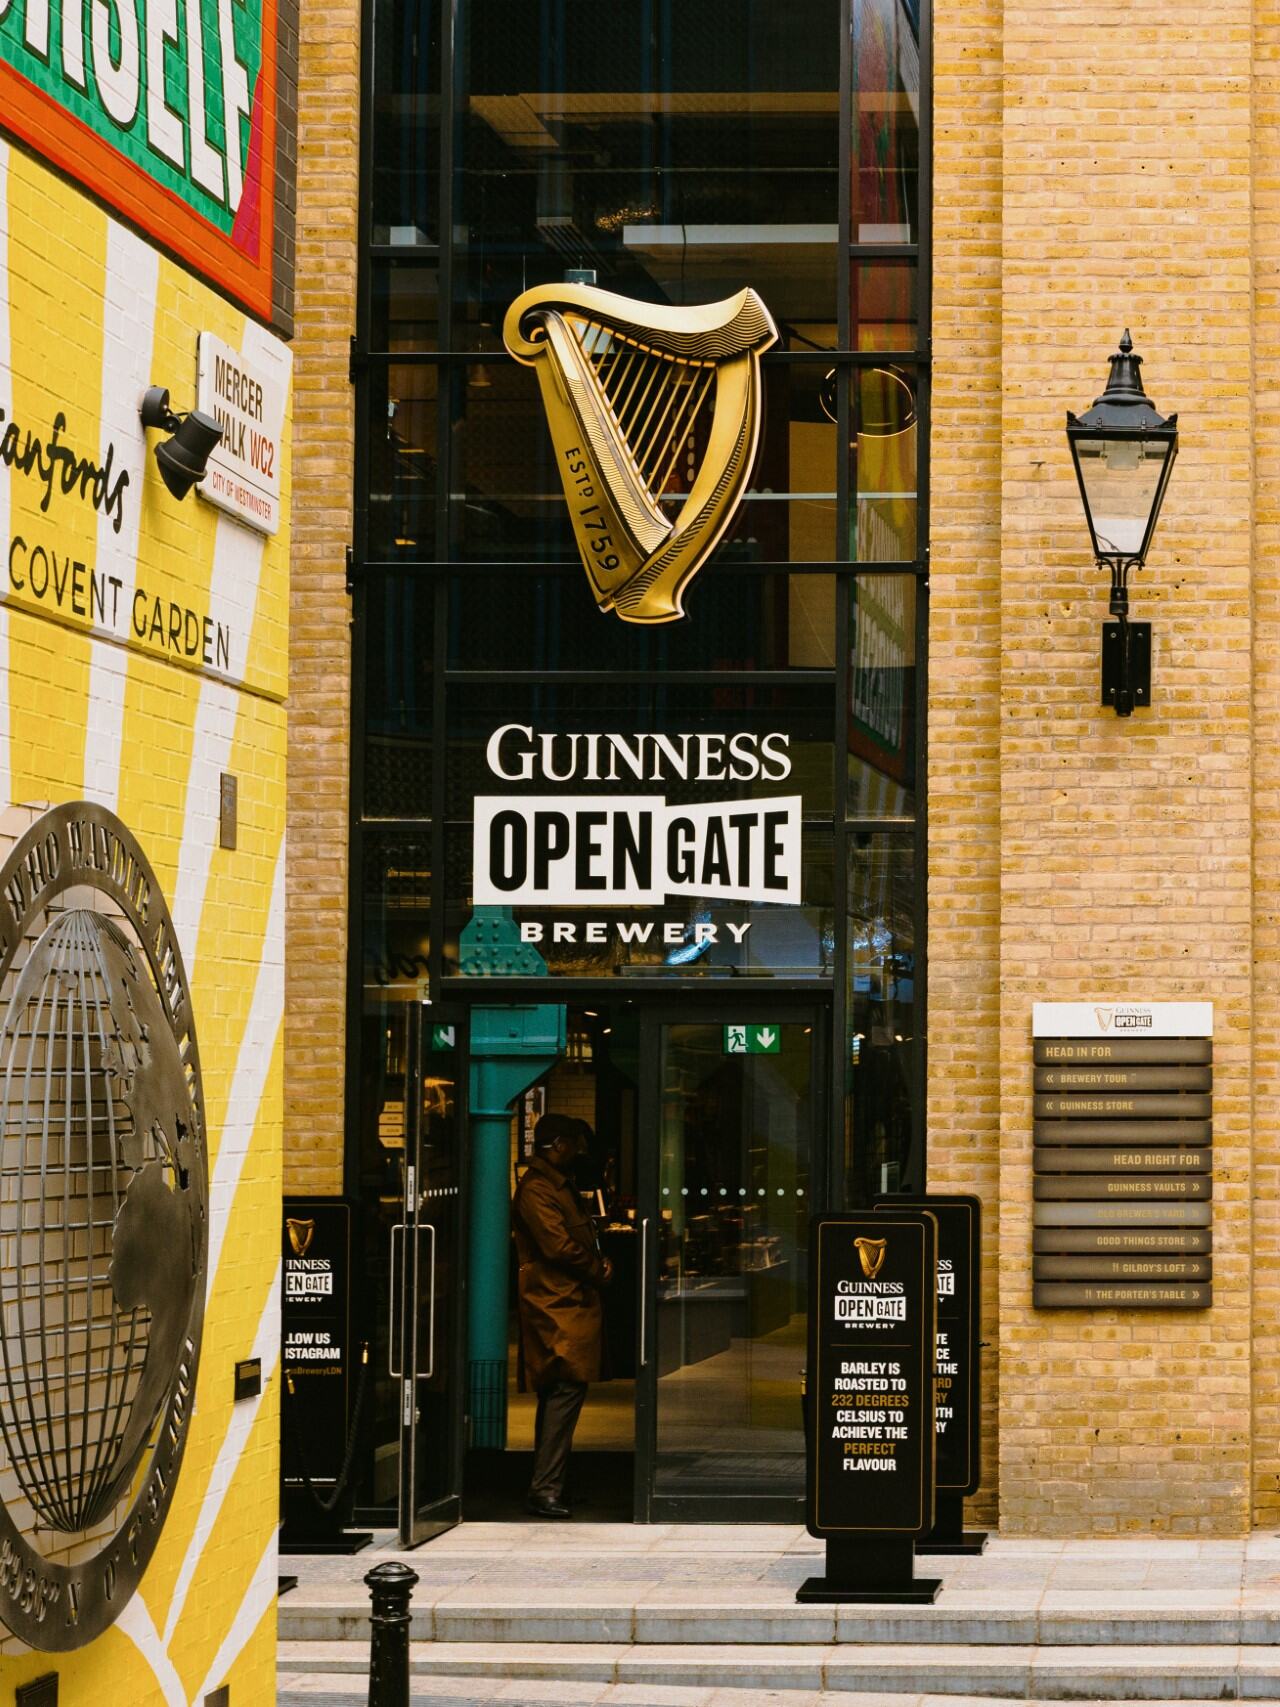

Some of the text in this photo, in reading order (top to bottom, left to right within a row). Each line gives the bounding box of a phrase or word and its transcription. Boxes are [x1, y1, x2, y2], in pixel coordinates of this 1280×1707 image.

[215, 355, 263, 423] MERCER
[249, 428, 275, 479] WC2
[0, 410, 130, 534] anfords
[212, 471, 272, 521] CITY OF WESTMINSTER
[578, 505, 620, 573] 1759
[8, 536, 230, 670] COVENT GARDEN
[486, 724, 792, 781] GUINNESS
[489, 809, 789, 892] OPEN GATE
[520, 922, 752, 943] BREWERY
[1116, 1016, 1152, 1027] OPEN GATE
[1046, 1047, 1112, 1057] HEAD IN FOR
[1060, 1074, 1128, 1083] BREWERY TOUR
[1060, 1101, 1134, 1110] GUINNESS STORE
[1113, 1155, 1200, 1165] HEAD RIGHT FOR
[1107, 1183, 1186, 1192] GUINNESS VAULTS
[1096, 1236, 1185, 1246] GOOD THINGS STORE
[1122, 1263, 1186, 1273] GILROY'S LOFT
[305, 1276, 330, 1291] GATE
[837, 1280, 904, 1294] GUINNESS
[1096, 1290, 1185, 1299] THE PORTER'S TABLE
[838, 1299, 903, 1317] OPEN GATE
[315, 1333, 331, 1344] US
[841, 1362, 900, 1375] BARLEY IS
[936, 1363, 958, 1374] THE
[834, 1378, 907, 1391] ROASTED TO
[831, 1395, 909, 1407] 232 DEGREES
[836, 1410, 904, 1423] CELSIUS TO
[832, 1426, 908, 1439] ACHIEVE THE
[844, 1443, 896, 1455] PERFECT
[843, 1458, 897, 1471] FLAVOUR
